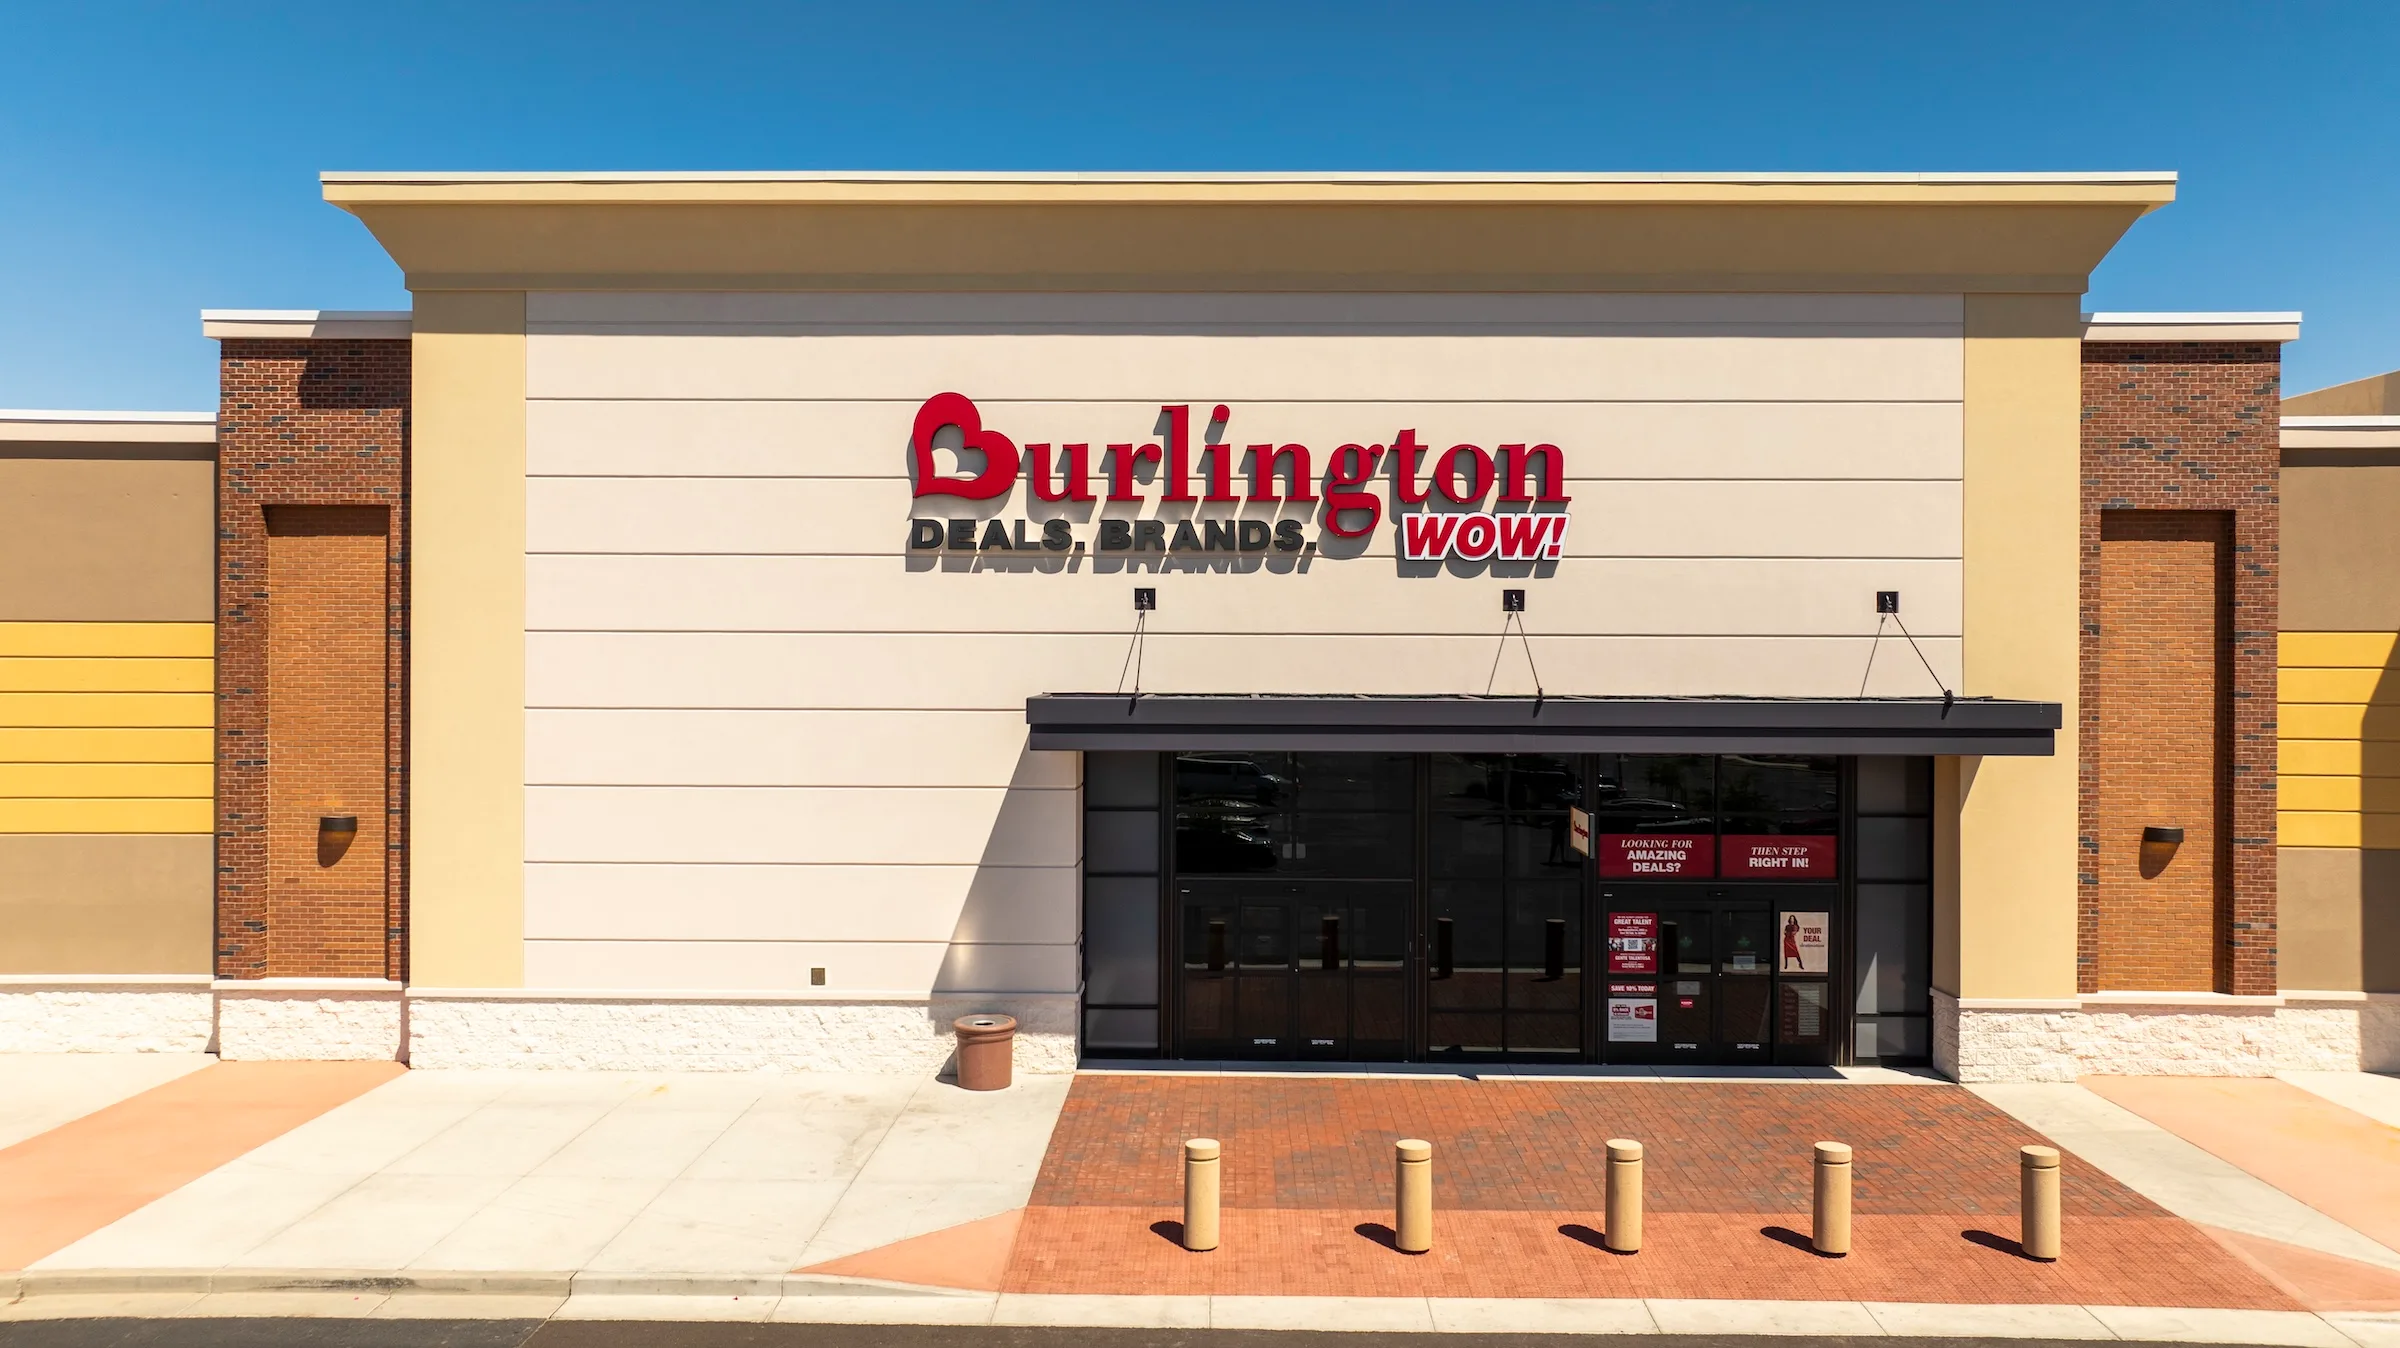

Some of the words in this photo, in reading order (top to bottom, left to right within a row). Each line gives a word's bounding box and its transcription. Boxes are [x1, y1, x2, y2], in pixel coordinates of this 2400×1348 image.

[912, 392, 1571, 538] Burlington
[911, 519, 1085, 551] DEALS.
[1102, 519, 1317, 551] BRANDS.
[1401, 513, 1570, 562] WOW!
[1621, 839, 1669, 849] LOOKING
[1671, 839, 1693, 849] FOR
[1627, 850, 1687, 861] AMAZING
[1751, 847, 1779, 856] THEN
[1781, 847, 1808, 856] STEP
[1632, 862, 1681, 873] DEALS?
[1749, 858, 1788, 868] RIGHT
[1792, 858, 1809, 868] IN!
[1803, 935, 1821, 943] DEAL
